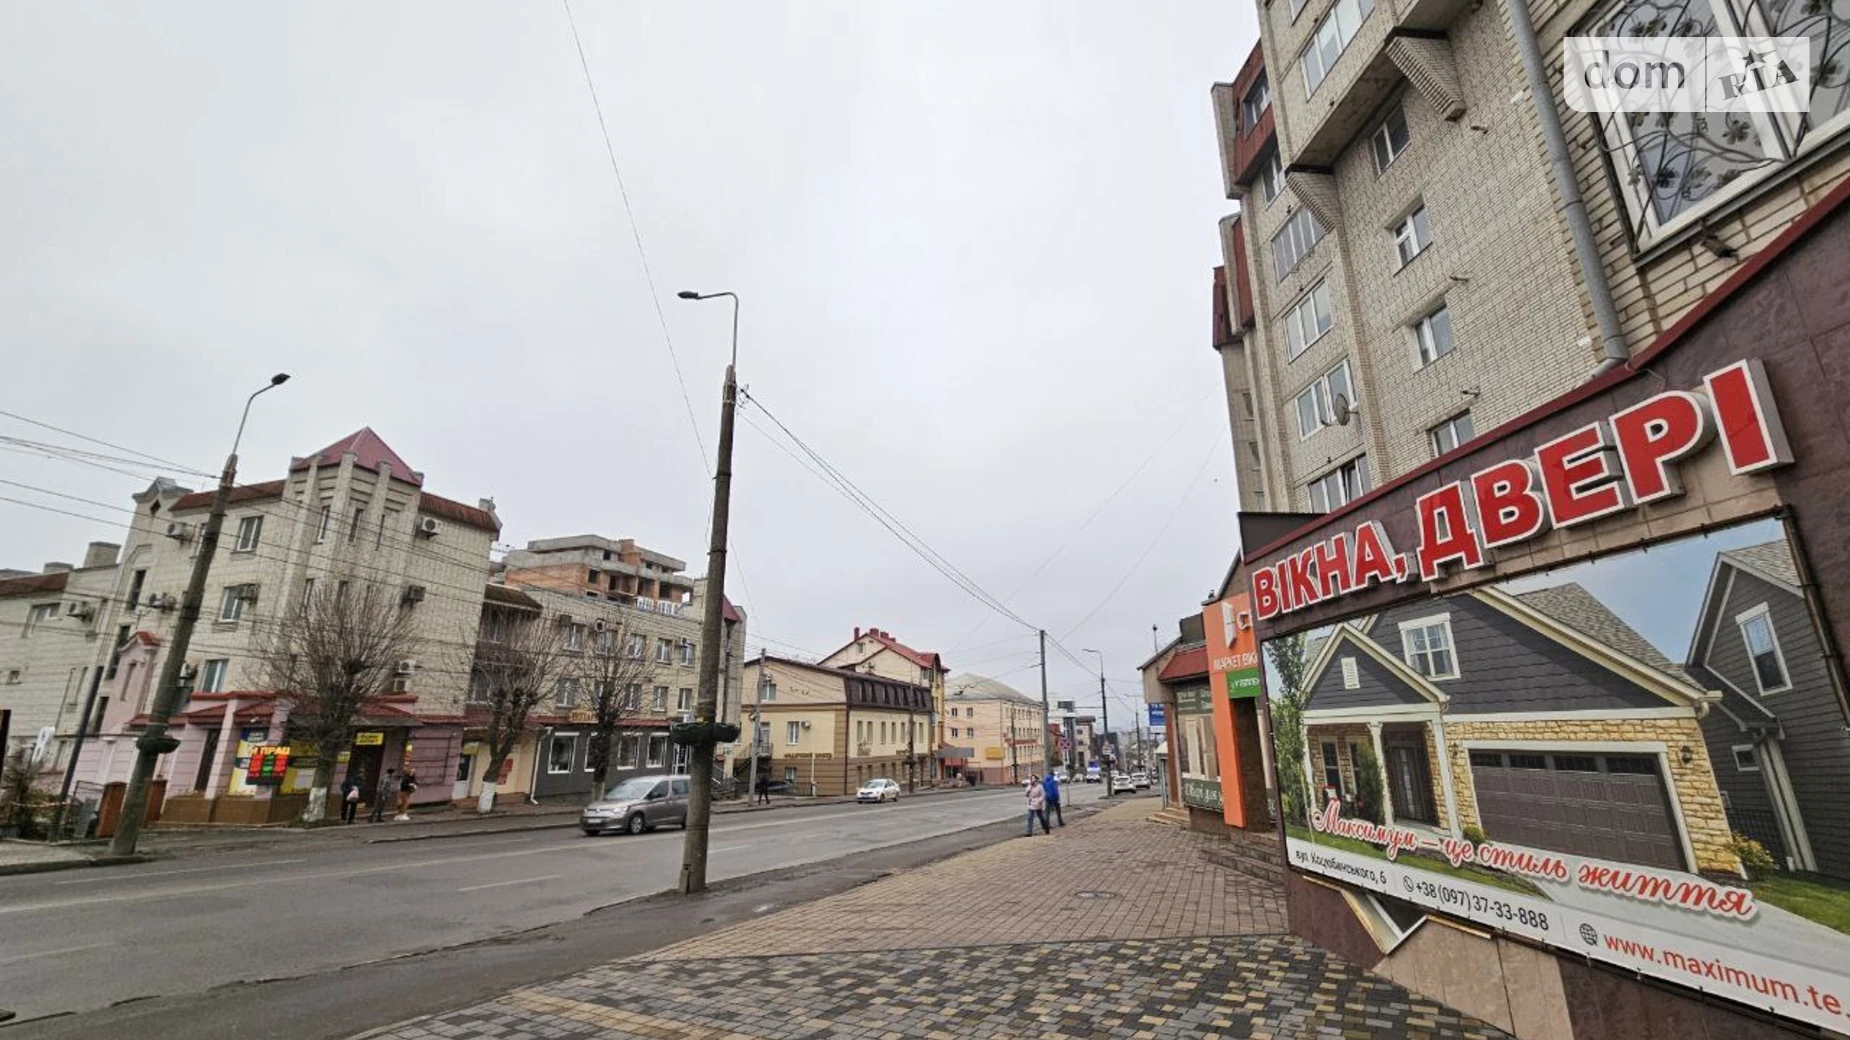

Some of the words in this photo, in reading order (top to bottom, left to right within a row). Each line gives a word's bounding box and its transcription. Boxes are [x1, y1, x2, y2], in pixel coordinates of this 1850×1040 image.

[1251, 520, 1409, 621] ВІКНА,
[1415, 359, 1783, 582] ДВЕРІ
[1312, 800, 1416, 859] Максимум
[1445, 841, 1473, 866] це
[1478, 842, 1569, 879] стиль
[1577, 862, 1754, 917] життя
[1379, 871, 1387, 884] 6
